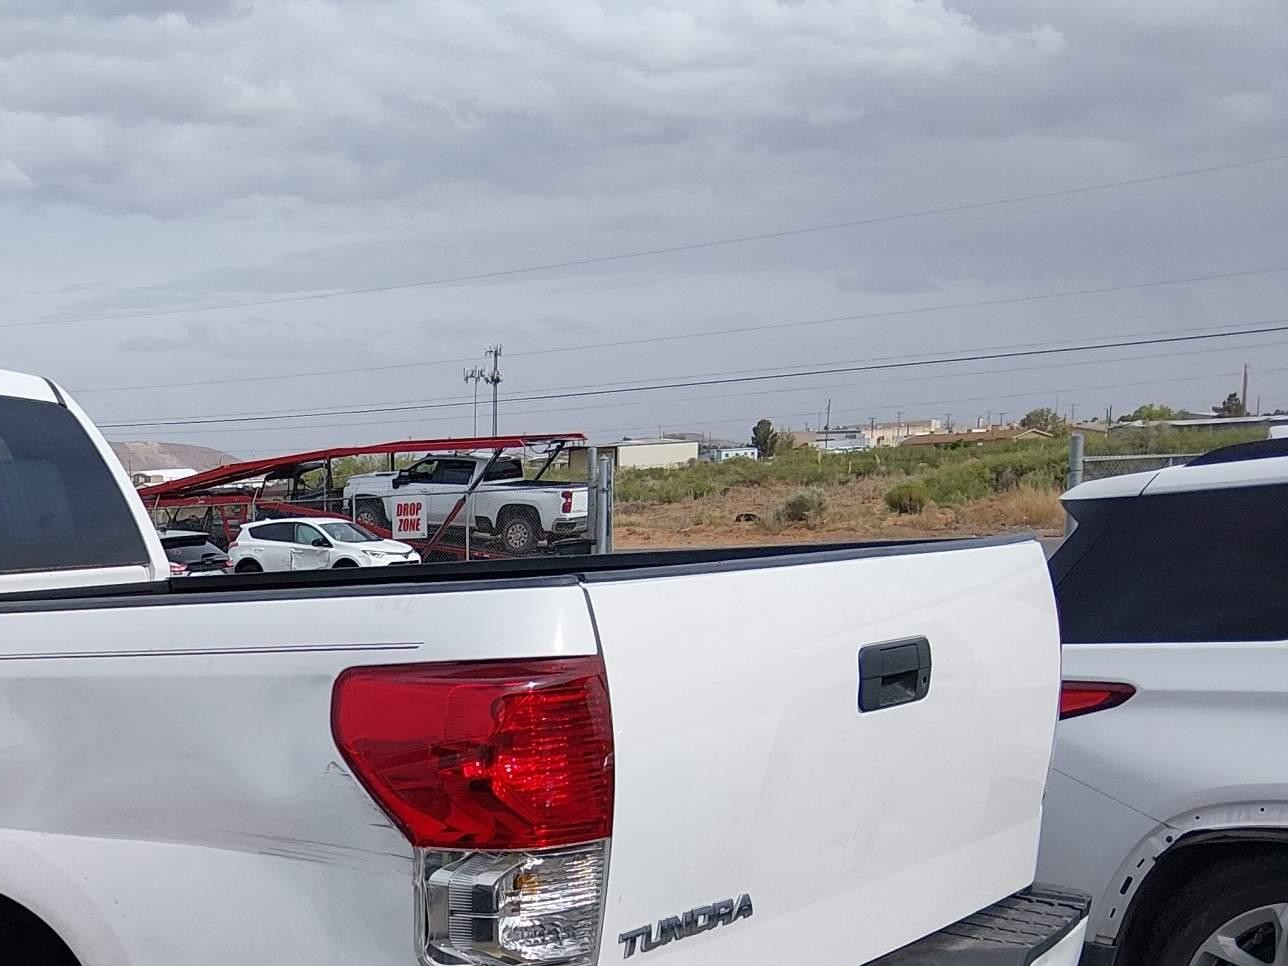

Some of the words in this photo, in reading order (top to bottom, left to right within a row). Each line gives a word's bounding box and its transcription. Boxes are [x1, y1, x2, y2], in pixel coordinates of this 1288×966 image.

[396, 502, 422, 517] DROP
[398, 518, 421, 532] ZONE
[618, 893, 753, 960] TUNDRA
